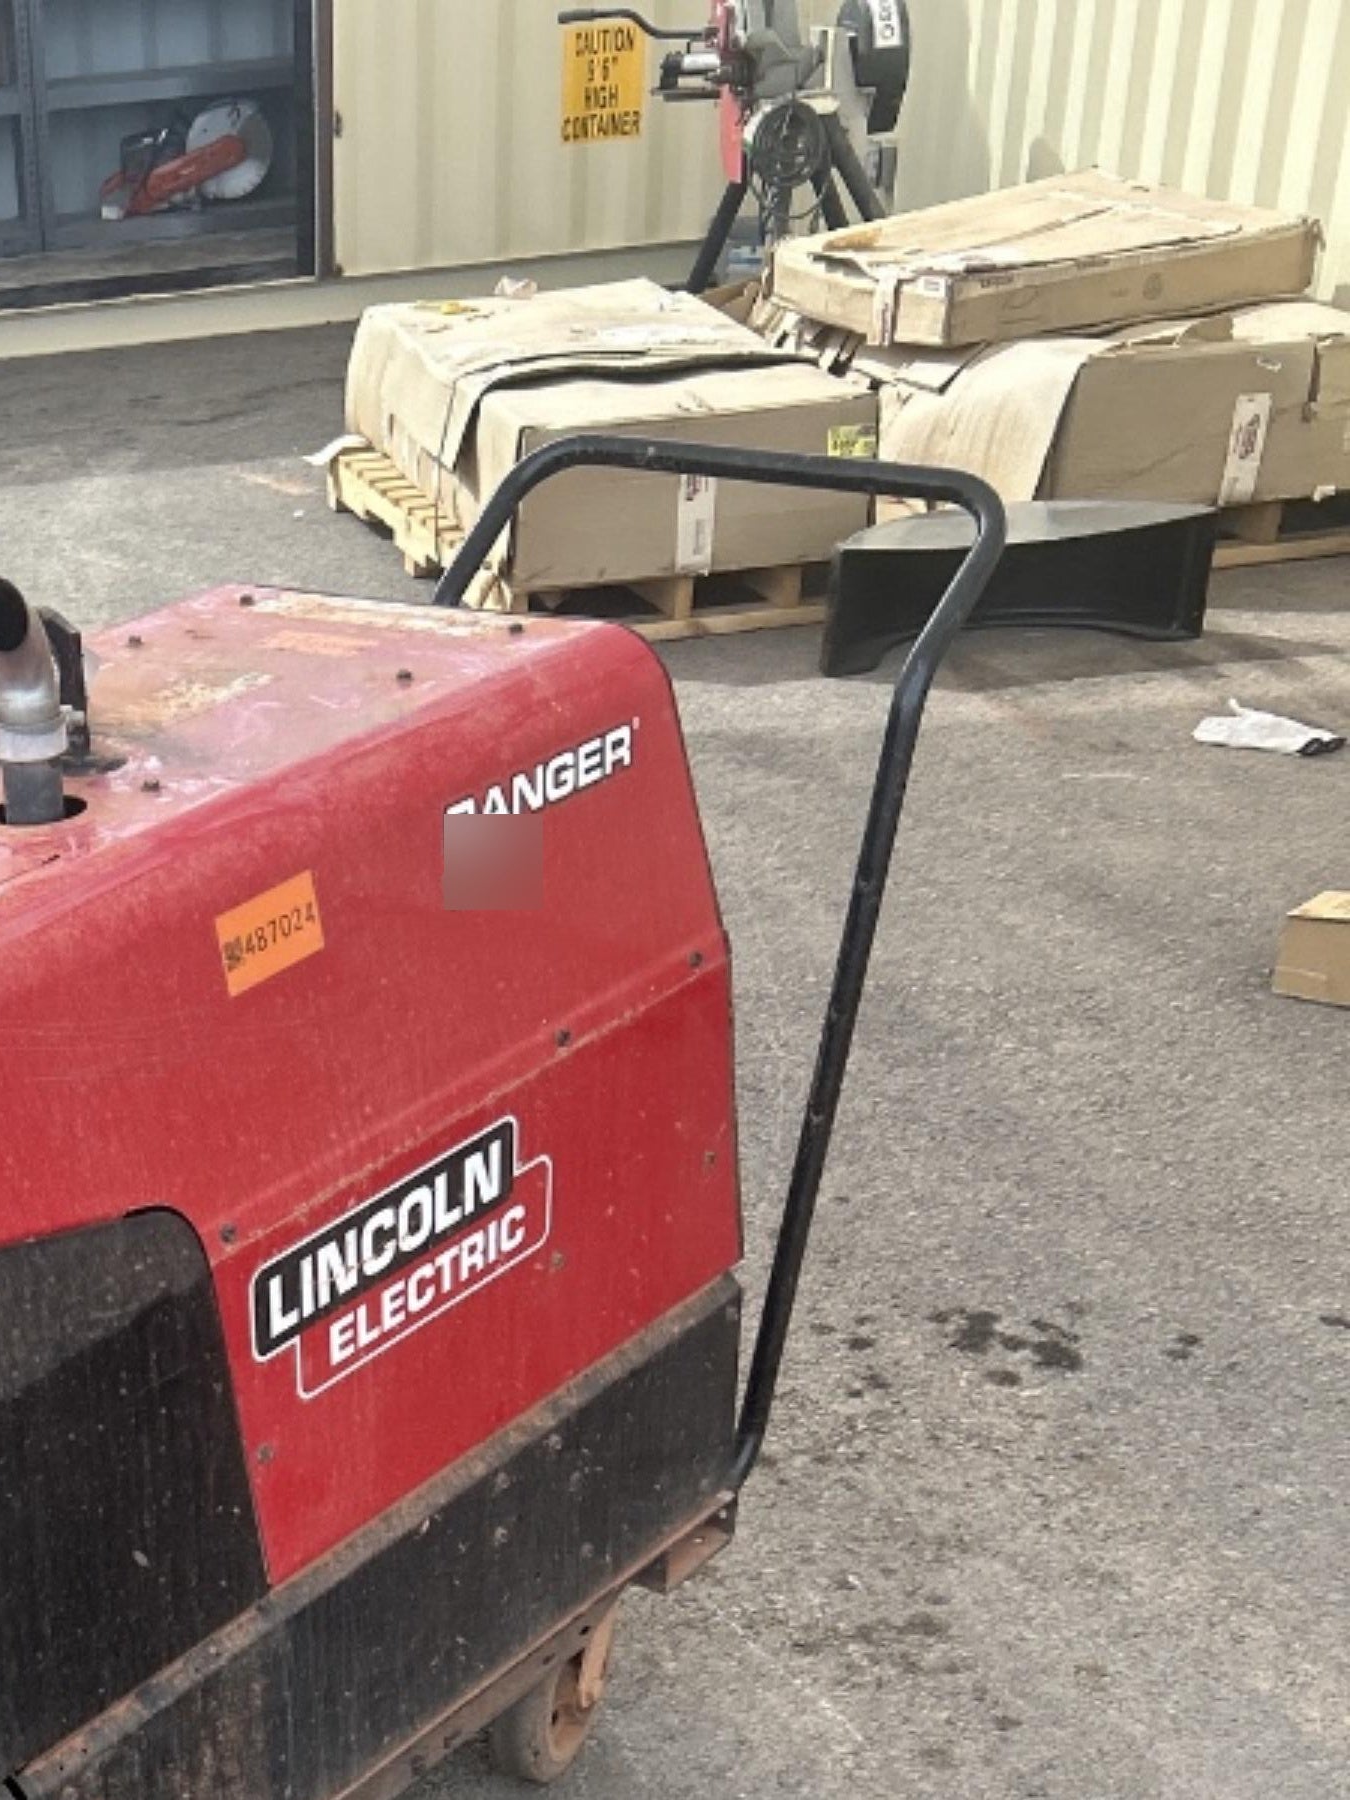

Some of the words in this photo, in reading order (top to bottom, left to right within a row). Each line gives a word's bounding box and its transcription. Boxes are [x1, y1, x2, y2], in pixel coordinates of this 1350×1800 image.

[575, 26, 634, 56] CAUTION
[584, 84, 619, 109] HIGH
[561, 110, 640, 141] CONTAINER
[245, 901, 316, 955] 487024
[268, 1139, 502, 1339] LINCOLN
[329, 1204, 526, 1366] ELECTRIC
